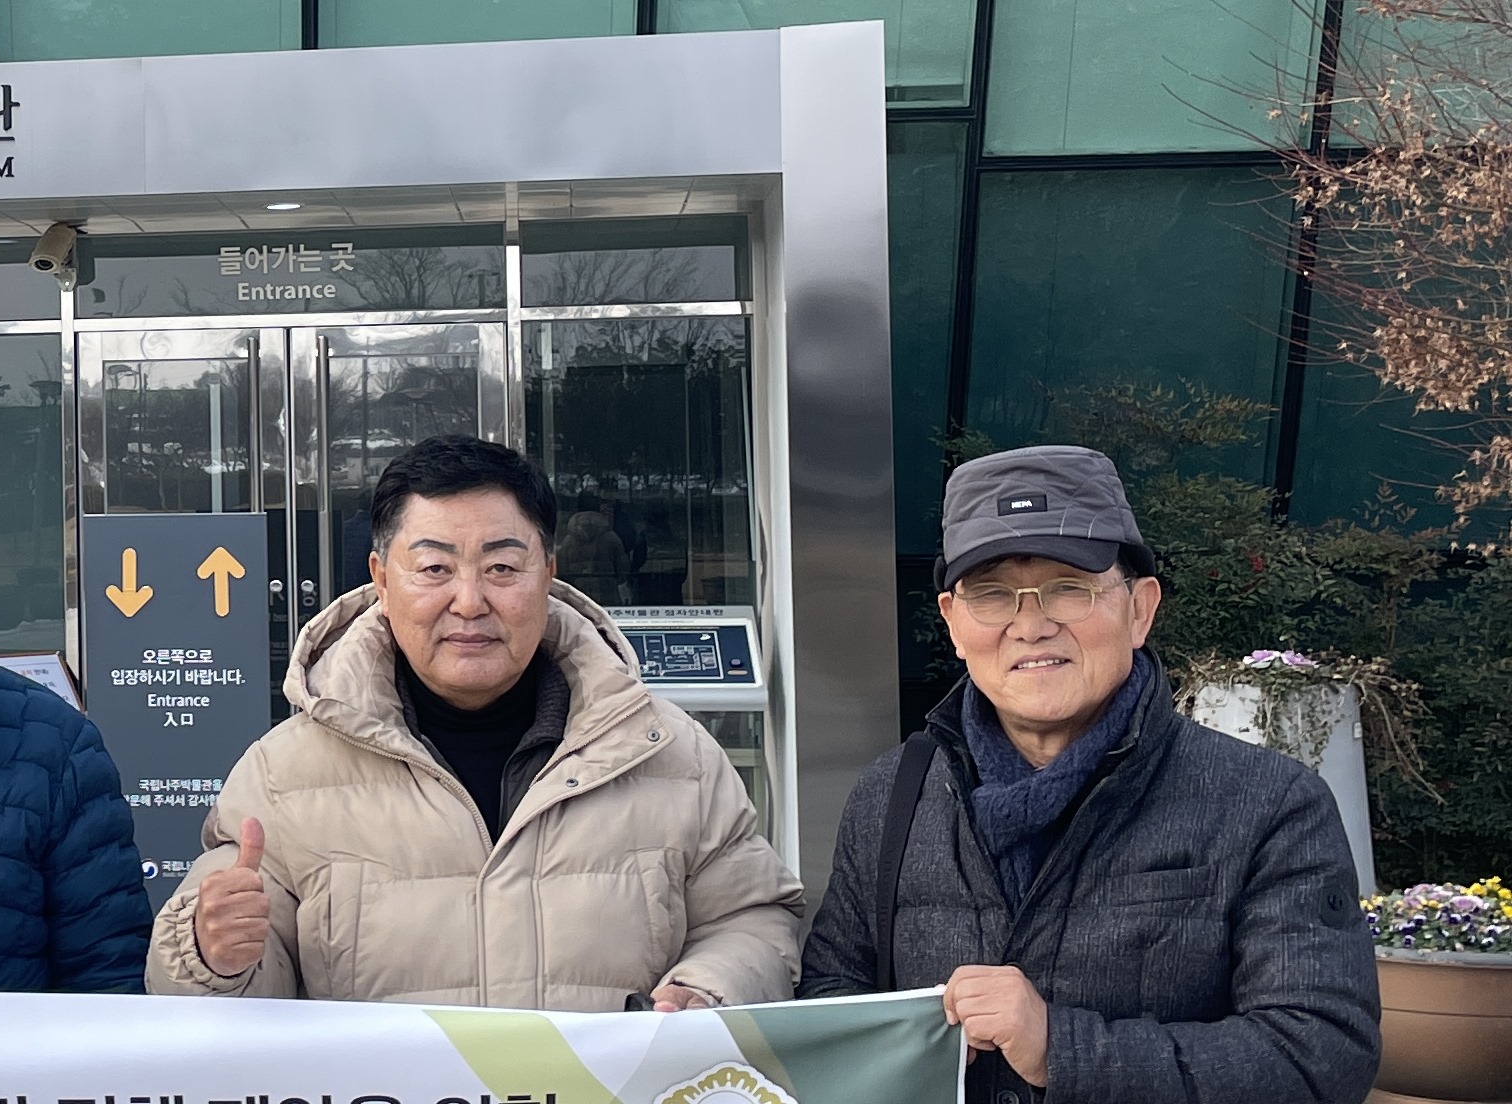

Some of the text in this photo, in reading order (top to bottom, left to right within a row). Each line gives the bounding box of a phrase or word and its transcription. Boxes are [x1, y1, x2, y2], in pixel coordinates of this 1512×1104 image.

[218, 243, 355, 275] 들어가는 곳
[238, 282, 336, 300] Entrance
[142, 649, 213, 665] 오른쪽으로
[111, 669, 245, 685] 입장하시기 바랍니다.
[148, 693, 210, 707] Entrance
[163, 712, 193, 727] 入口
[139, 779, 222, 791] 국립나주박물관을
[124, 794, 151, 807] 문해
[154, 794, 185, 806] 주셔서
